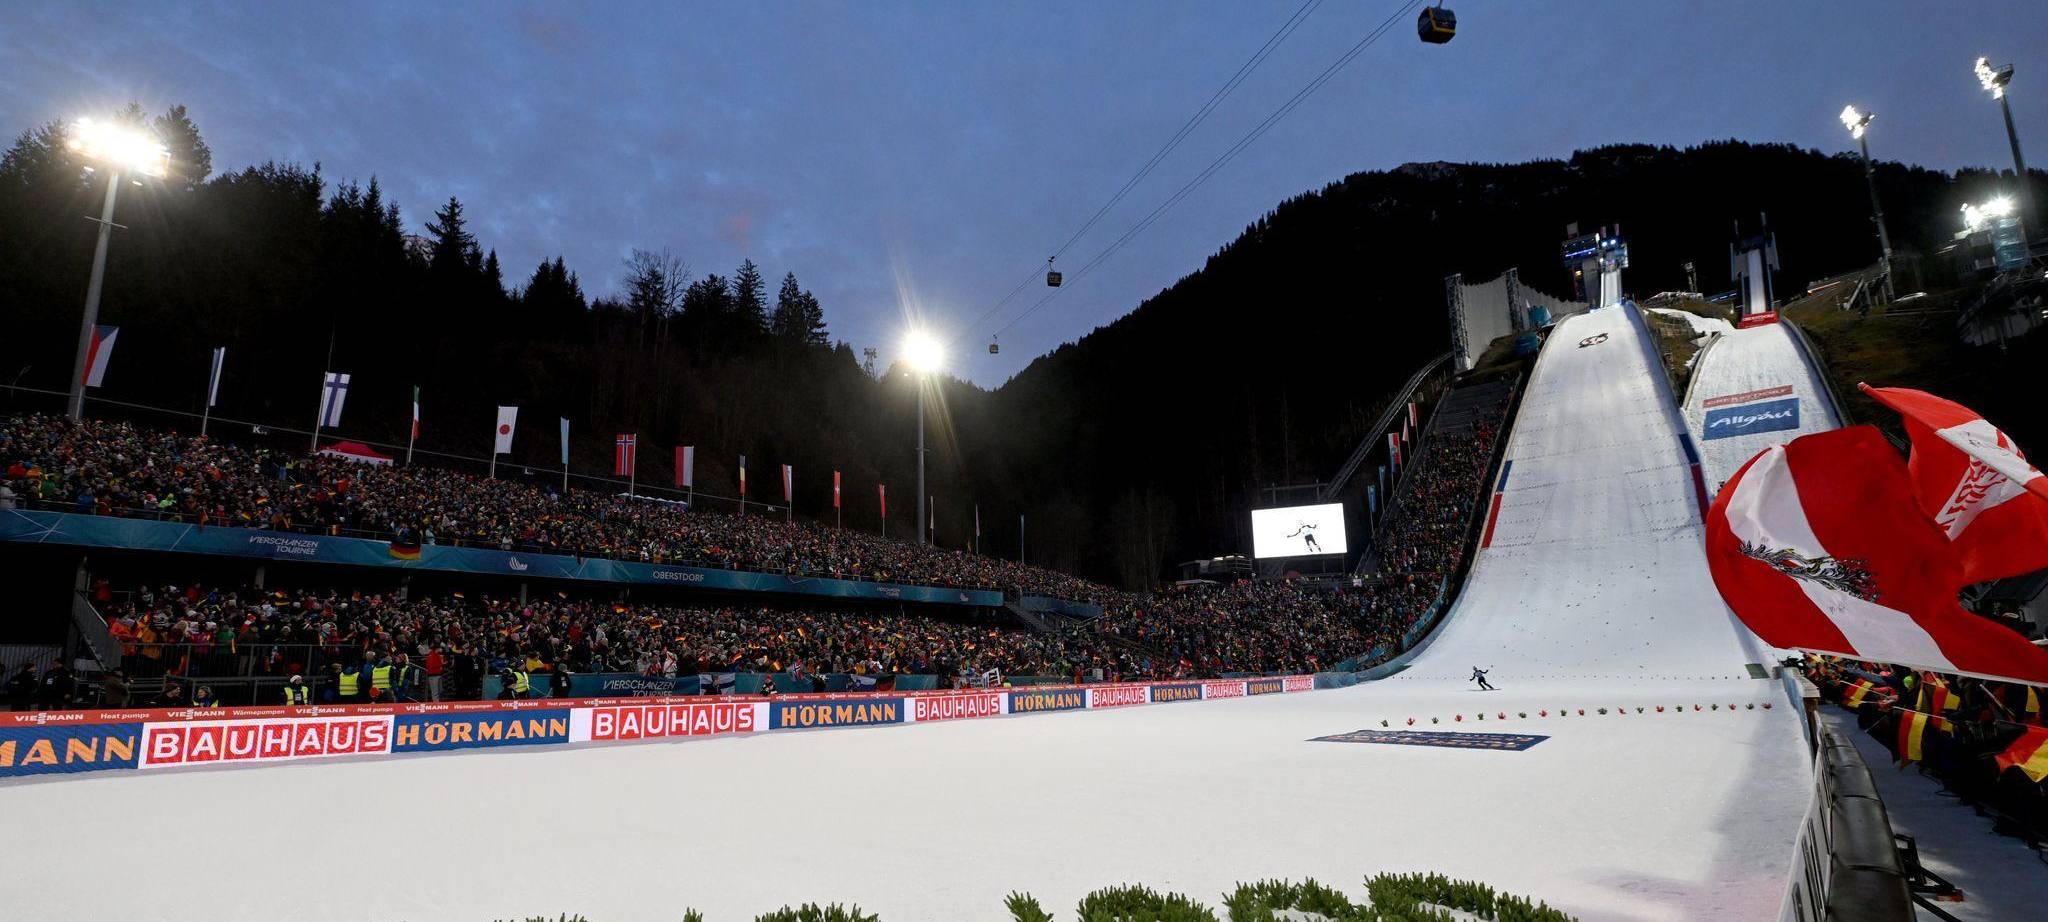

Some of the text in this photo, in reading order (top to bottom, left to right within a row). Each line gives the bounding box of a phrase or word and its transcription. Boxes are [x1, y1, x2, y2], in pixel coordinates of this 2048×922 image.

[249, 536, 319, 548] VIERSCHANZEN
[652, 570, 705, 582] OBERSTDORF
[602, 679, 676, 691] VIERSCHANZEN
[1207, 684, 1243, 698] BAUHAUS
[1249, 682, 1281, 694] HÖRMANN
[1285, 678, 1312, 691] BAUHAUS
[1014, 692, 1081, 711] HÖRMANN
[1093, 689, 1145, 706] BAUHAUS
[1154, 687, 1199, 701] HÖRMANN
[15, 712, 84, 725] VIESSMANN
[121, 712, 150, 721] pumps
[167, 708, 226, 720] VIESSMANN
[233, 708, 285, 717] Wärmepumpen
[295, 706, 346, 716] VIESSMANN
[372, 706, 394, 714] pumps
[405, 703, 449, 713] VIESSMANN
[500, 700, 539, 709] VIESSMANN
[781, 703, 896, 727] HÖRMANN
[917, 697, 999, 718] BAUHAUS
[595, 707, 753, 736] BAUHAUS
[396, 718, 567, 746] HÖRMANN
[153, 724, 386, 759] BAUHAUS
